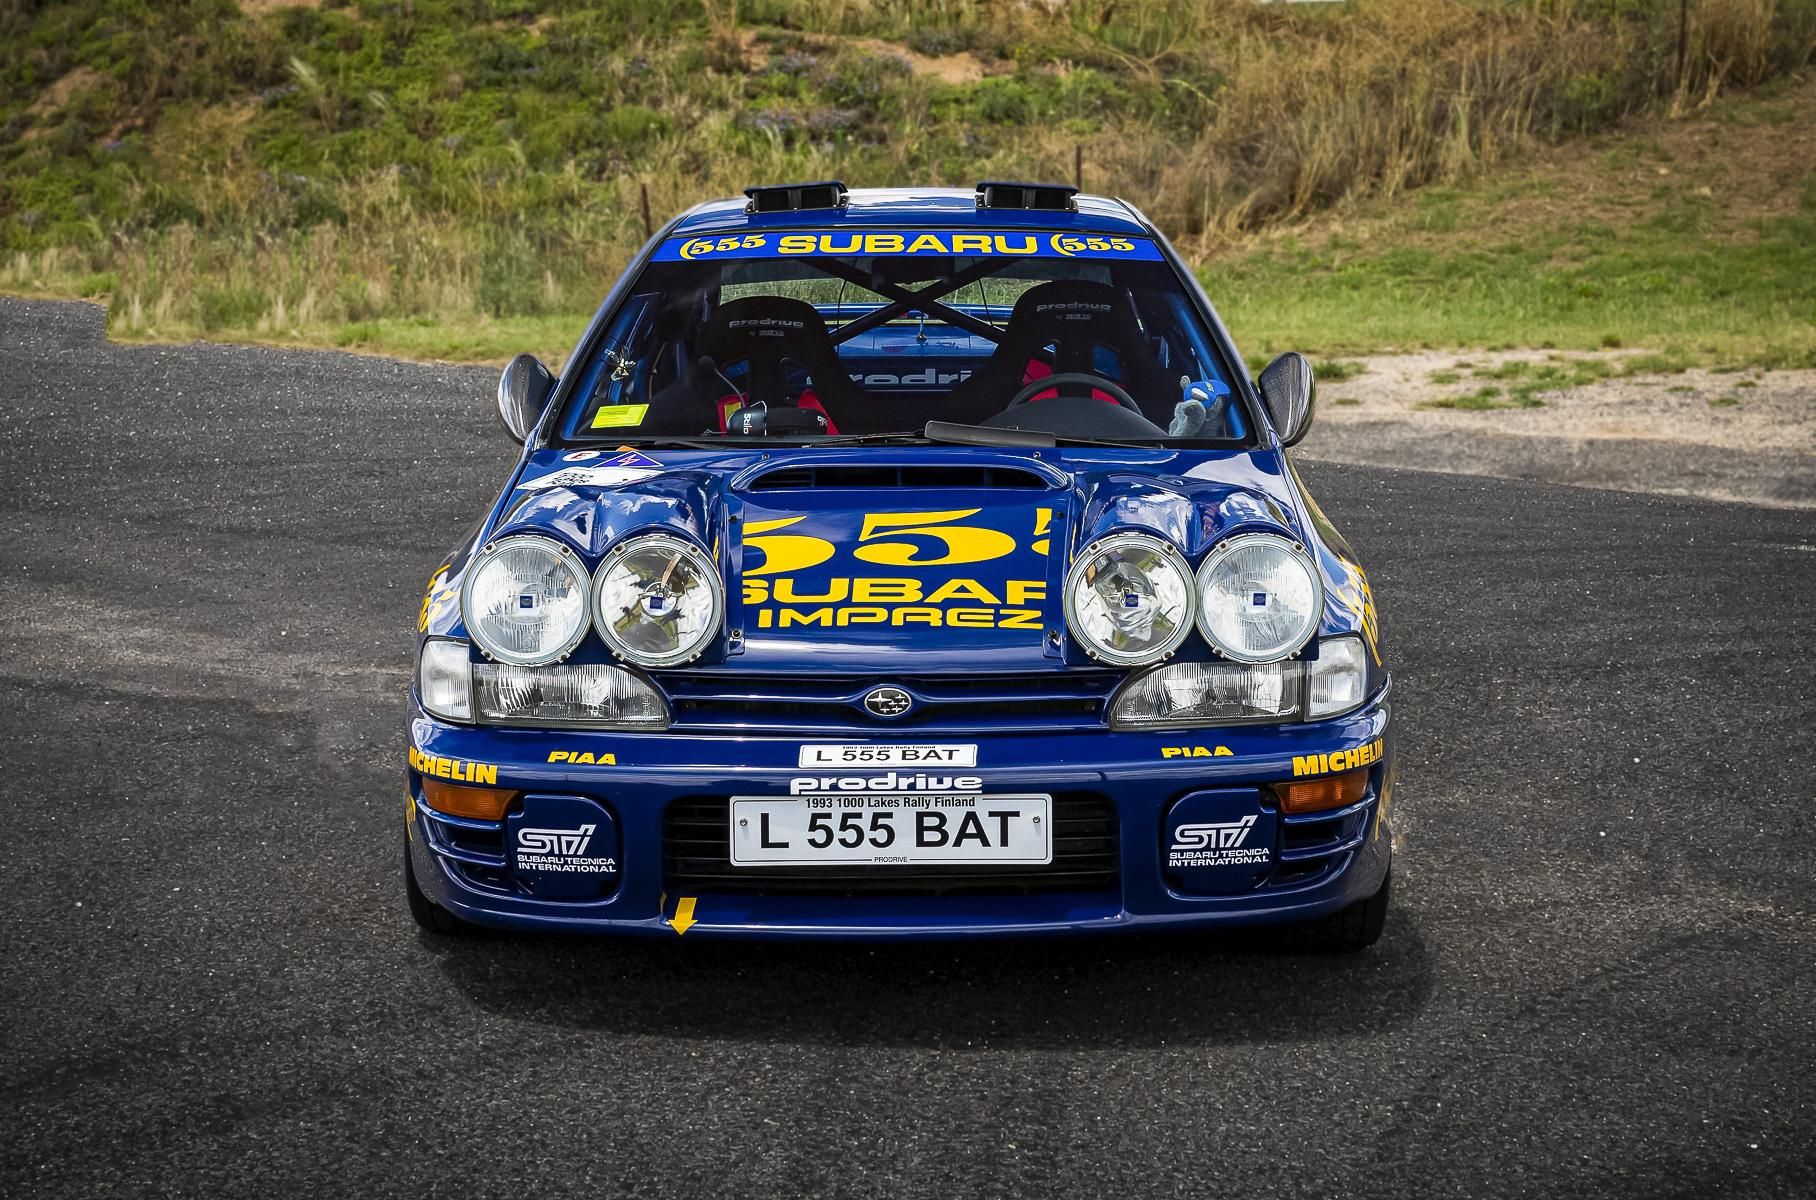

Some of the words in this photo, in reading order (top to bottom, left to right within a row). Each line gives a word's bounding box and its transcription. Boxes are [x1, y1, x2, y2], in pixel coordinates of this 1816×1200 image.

[777, 234, 1038, 254] SUBARU
[742, 508, 1052, 576] 55
[757, 607, 1043, 629] IMPREZ
[547, 751, 616, 765] PIAA
[816, 750, 832, 762] L
[842, 750, 891, 762] 555
[901, 749, 960, 761] BAT
[1161, 745, 1234, 758] PIAA
[790, 772, 983, 795] prodrive
[806, 798, 833, 808] 1993
[837, 797, 864, 808] 1000
[868, 797, 900, 808] Lakes
[904, 797, 930, 809] Rally
[935, 796, 976, 808] Finland
[760, 812, 789, 848] L
[807, 812, 896, 848] 555
[916, 811, 1021, 848] BAT
[517, 854, 564, 864] SUBARU
[565, 857, 616, 865] TECNICA
[1169, 851, 1219, 859] SUBARU
[1220, 847, 1270, 857] TECNICA
[518, 862, 617, 872] INTERNATIONAL
[1168, 855, 1269, 867] INTERNATIONAL
